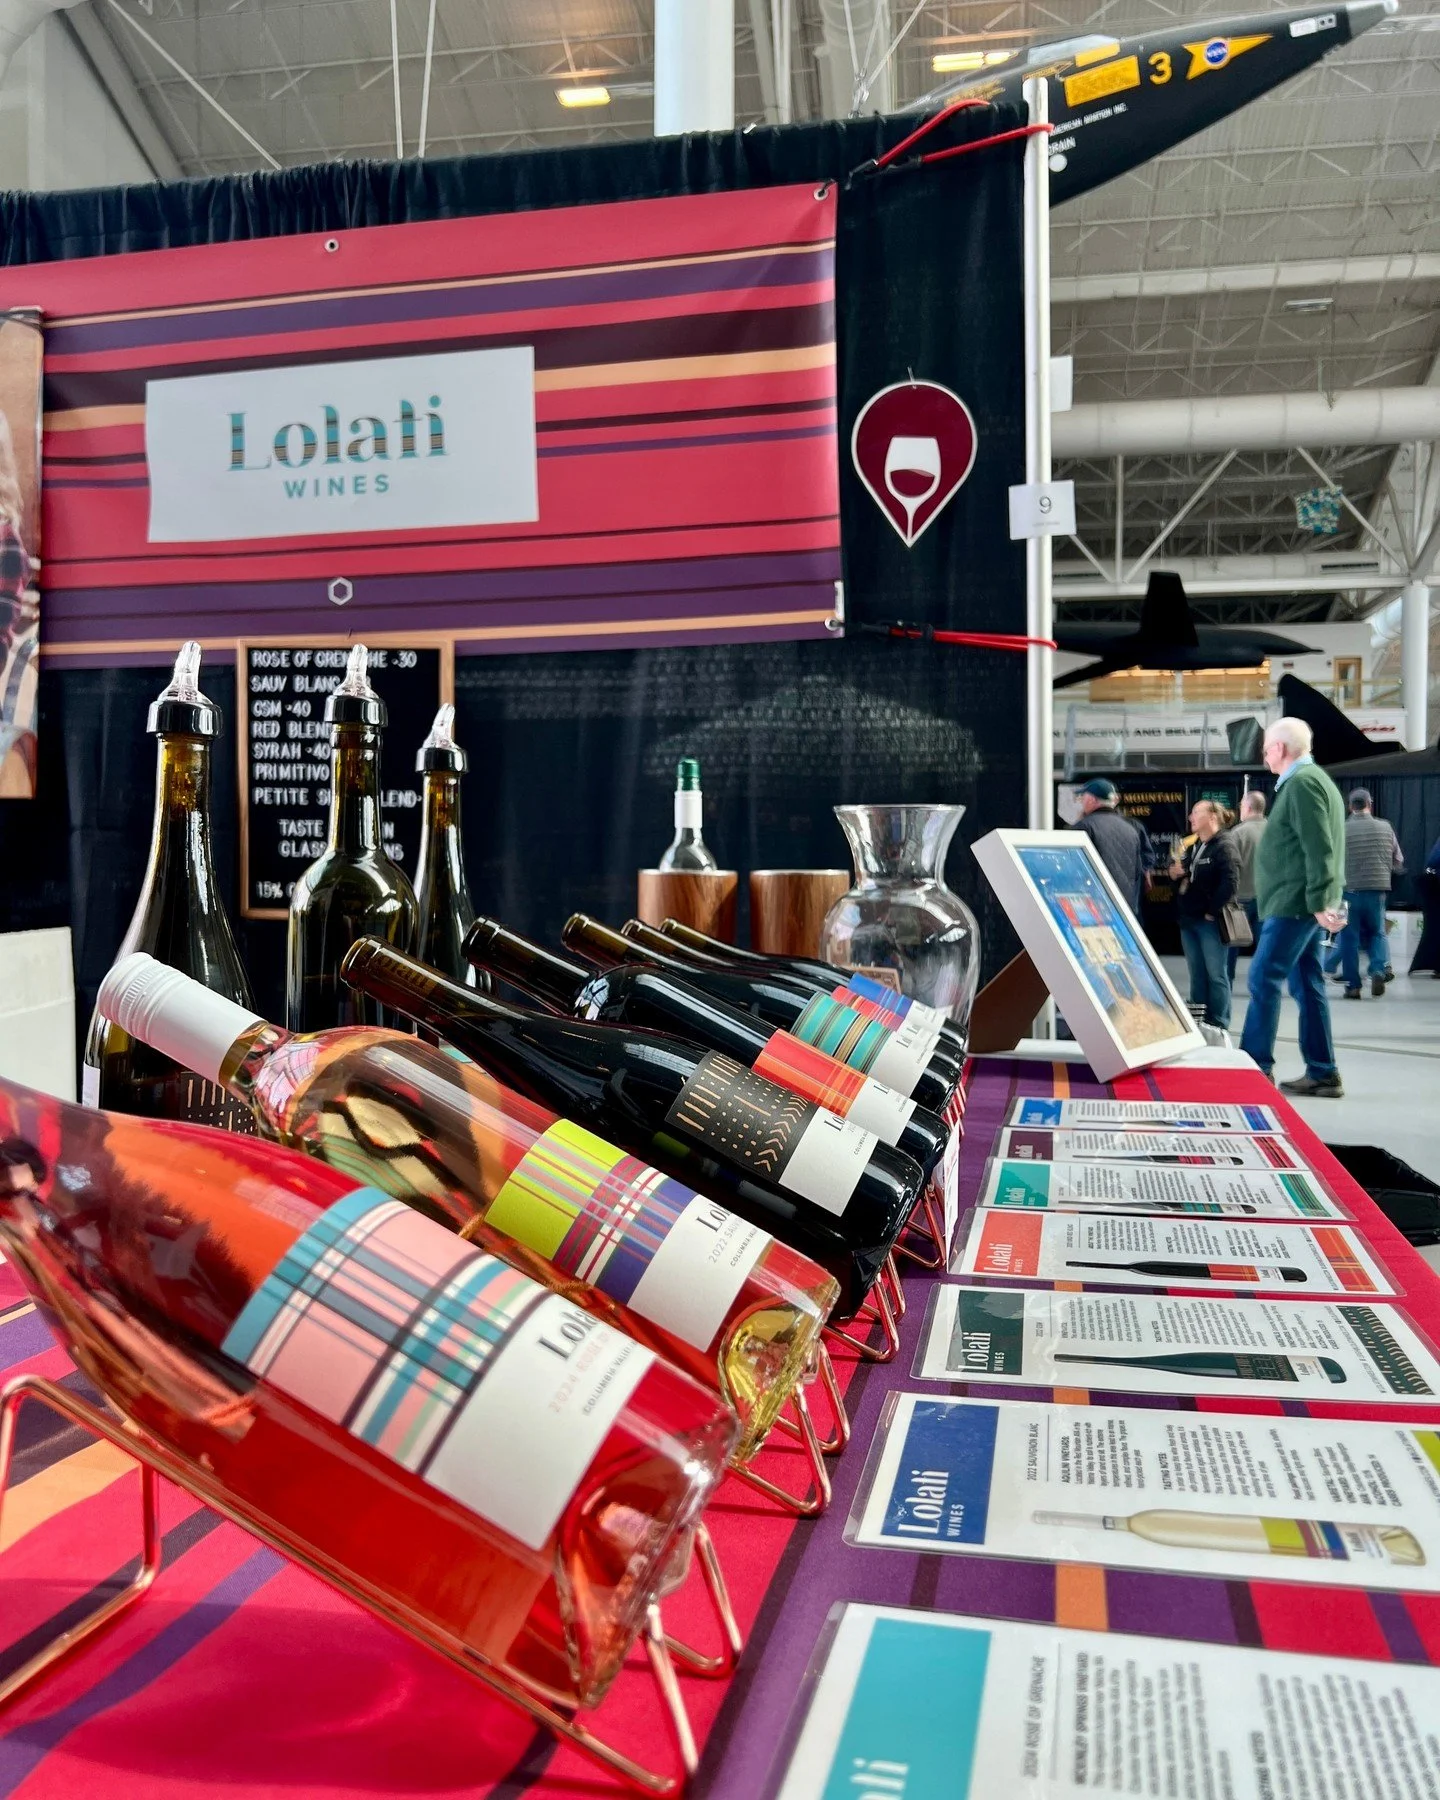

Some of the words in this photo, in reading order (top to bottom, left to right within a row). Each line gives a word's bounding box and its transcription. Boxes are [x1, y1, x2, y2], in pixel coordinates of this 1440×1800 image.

[1149, 52, 1172, 85] 3
[226, 395, 450, 472] Lolati
[283, 474, 390, 498] WINES
[1040, 496, 1052, 514] 9
[251, 650, 290, 668] ROSE
[293, 650, 313, 668] OF
[314, 650, 388, 668] GRENHE
[250, 675, 287, 693] SAUV
[252, 721, 281, 739] RED
[1134, 728, 1161, 737] AND
[252, 742, 302, 760] SYRAH
[255, 763, 330, 781] PRIMITIVO
[254, 787, 309, 805] PETITE
[1123, 792, 1182, 803] MOUNTAIN
[278, 818, 324, 838] TASTE
[256, 880, 283, 899] 15%
[708, 1237, 728, 1264] 2022
[730, 1237, 750, 1267] COLUMBIA
[983, 1243, 1013, 1272] Lolati
[958, 1332, 991, 1371] Lolati
[993, 1351, 1005, 1372] WINES
[583, 1366, 617, 1417] COLUMBIA
[1029, 1423, 1039, 1437] BLANC
[1028, 1438, 1038, 1467] SAUVIGNON
[1027, 1468, 1037, 1480] 2022
[1161, 1470, 1172, 1490] TASTING
[898, 1470, 950, 1534] Lolati
[947, 1503, 965, 1537] WINES
